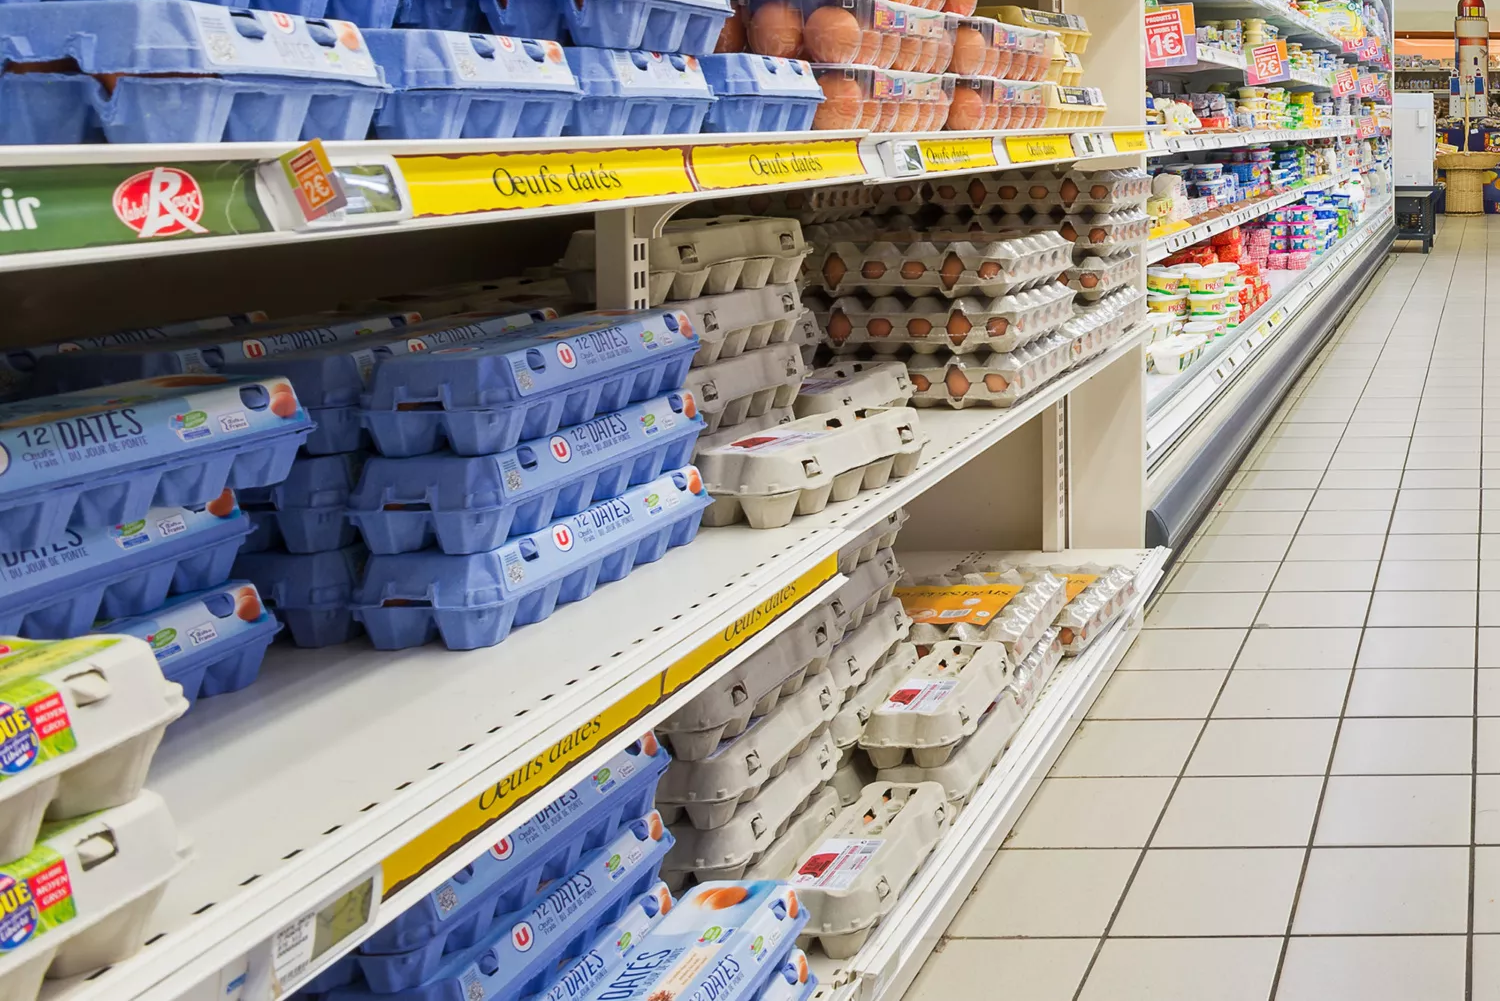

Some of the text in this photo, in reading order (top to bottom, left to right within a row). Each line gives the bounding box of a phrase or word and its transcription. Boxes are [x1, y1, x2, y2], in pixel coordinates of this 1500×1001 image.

[1150, 32, 1182, 57] 1€
[1258, 60, 1279, 77] 2€
[1339, 81, 1354, 94] 1€
[791, 151, 823, 174] datés
[567, 163, 622, 192] datés
[303, 175, 331, 205] 2€
[250, 344, 263, 358] U
[575, 336, 591, 351] 12
[558, 350, 572, 364] U
[17, 427, 50, 449] 12
[57, 408, 143, 451] DATÉS
[570, 426, 587, 442] 12
[68, 435, 149, 463] DU JOUR DE PONTE
[552, 441, 567, 458] U
[573, 513, 590, 529] 12
[556, 530, 569, 546] U
[9, 568, 22, 579] DU
[25, 561, 48, 577] JOUR
[61, 547, 88, 564] PONTE
[34, 704, 67, 726] MOYEN
[36, 873, 69, 896] MOYEN
[533, 869, 592, 919] 12 DATÉS
[515, 927, 530, 946] U
[565, 948, 604, 997] DATÉS
[700, 953, 741, 1001] DATÉS
